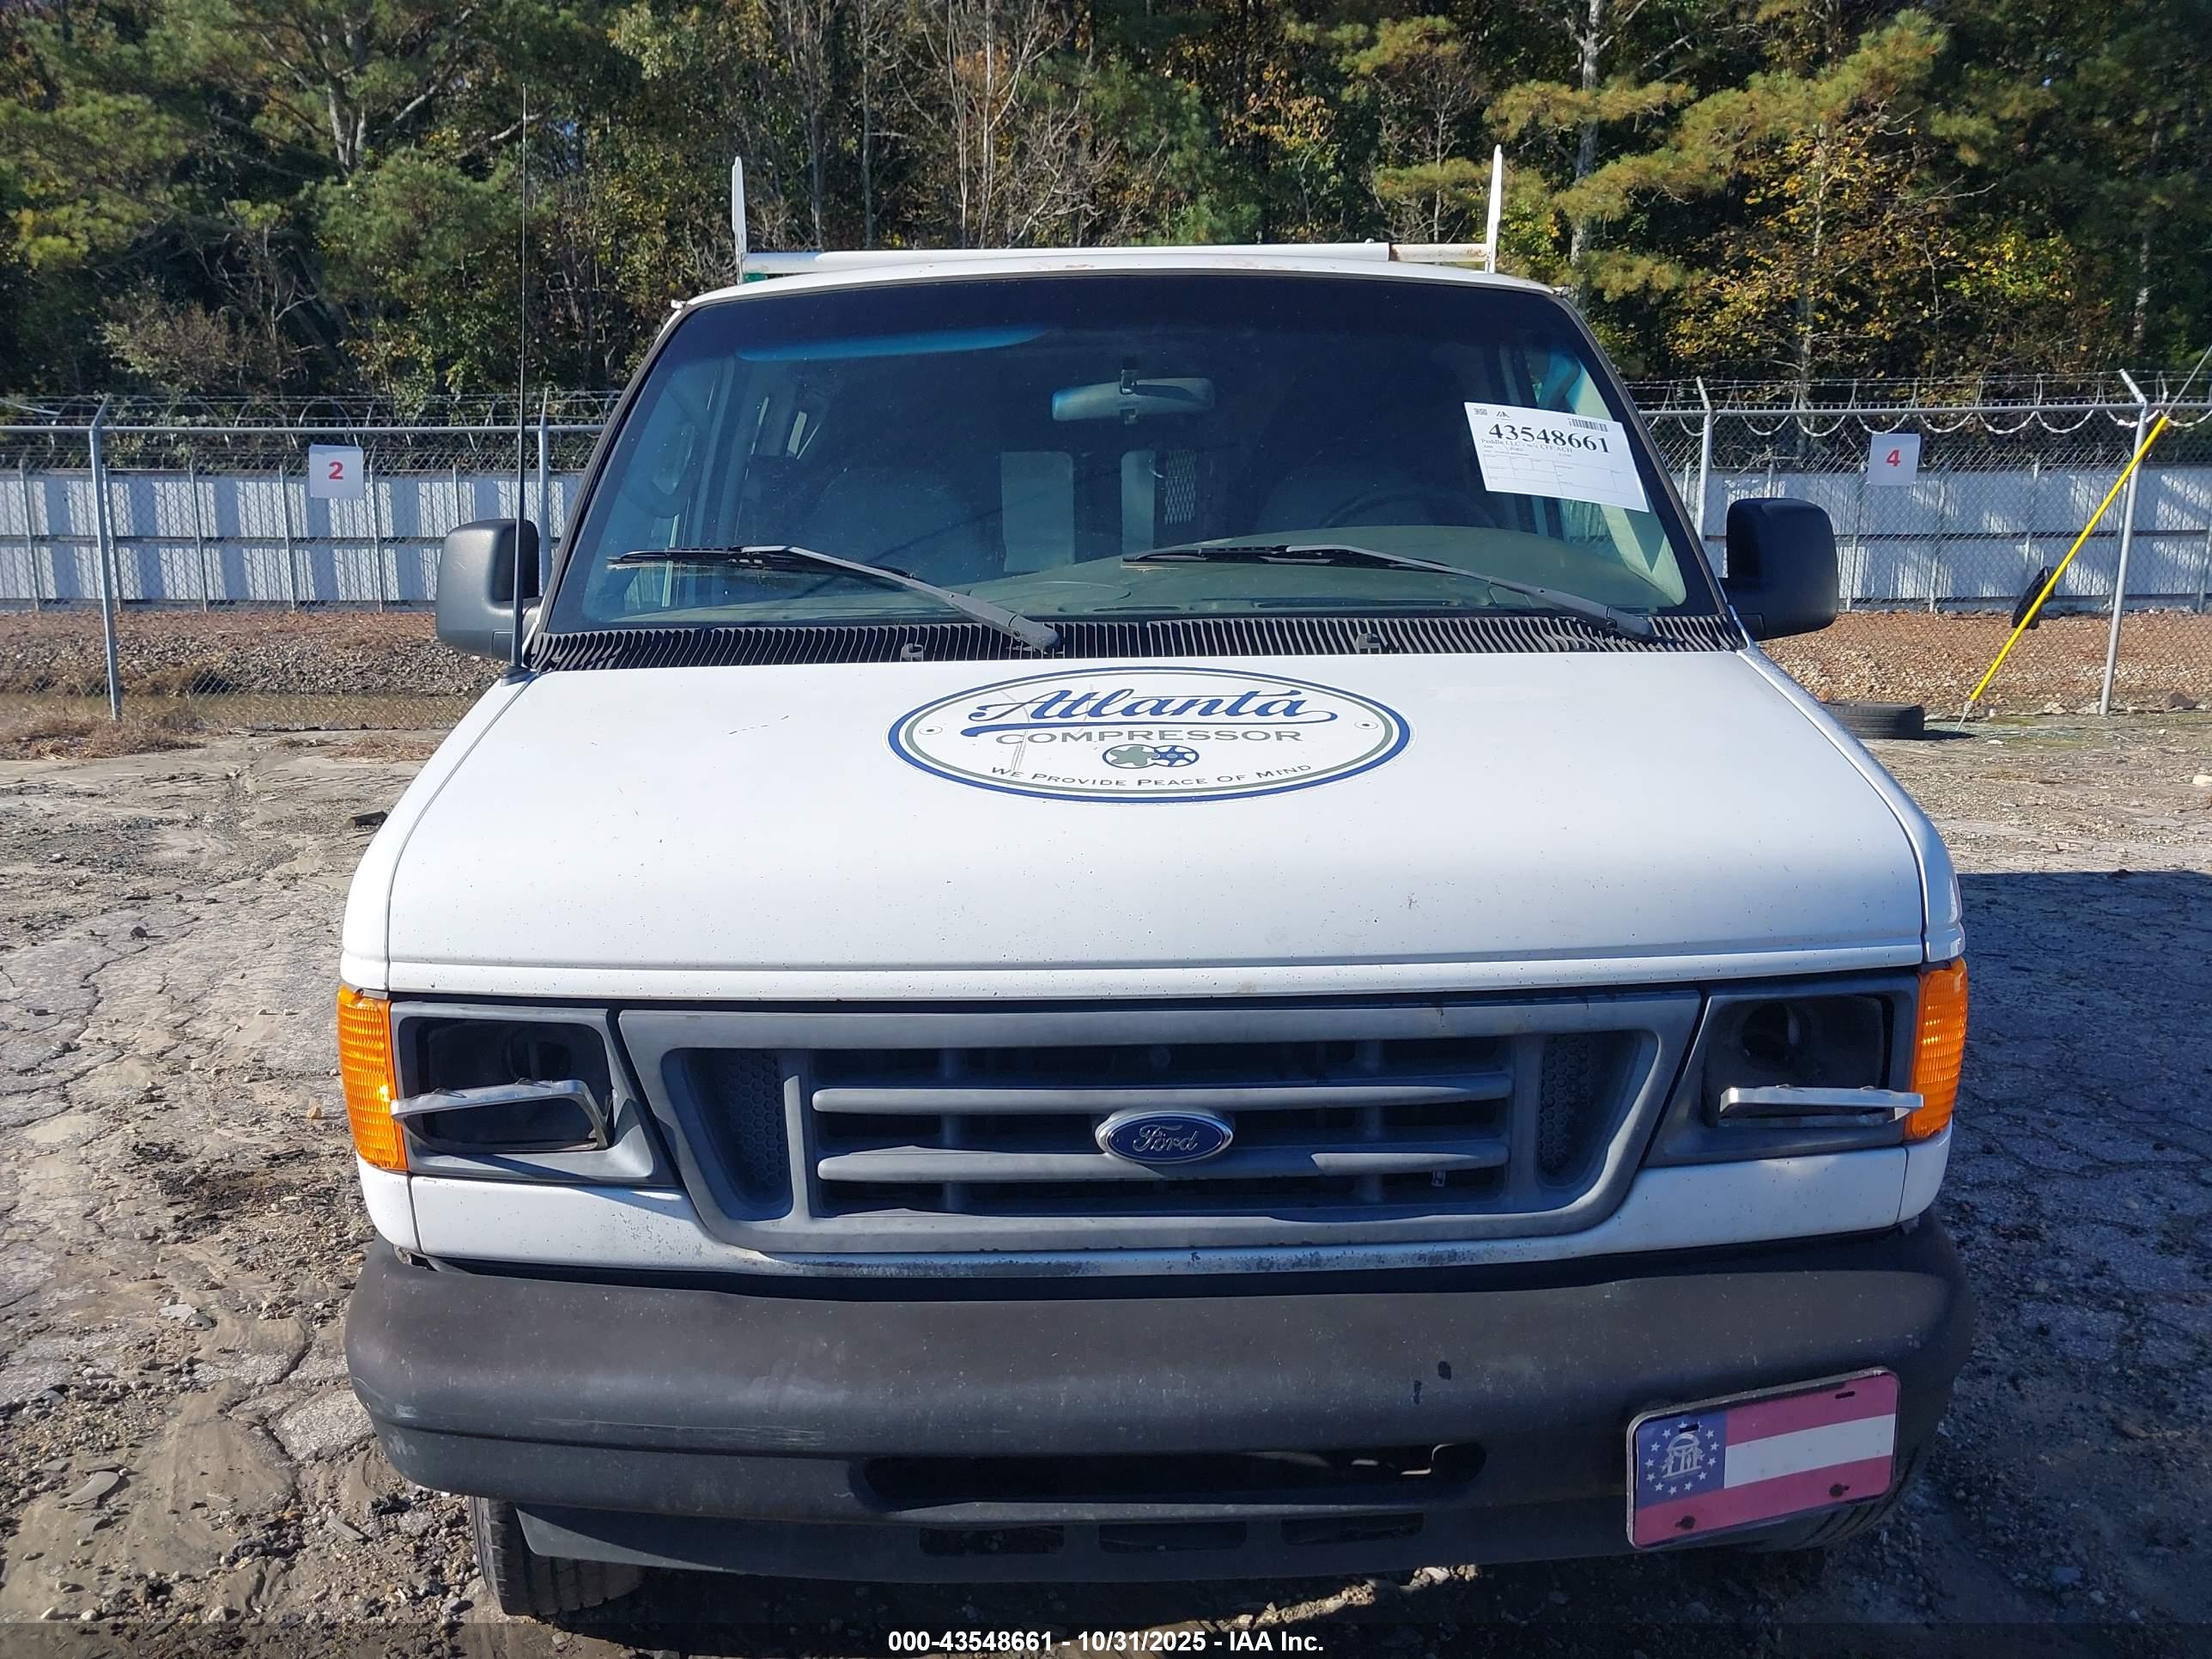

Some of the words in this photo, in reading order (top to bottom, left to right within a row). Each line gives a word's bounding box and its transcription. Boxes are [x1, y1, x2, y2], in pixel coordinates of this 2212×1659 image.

[1489, 422, 1611, 454] 43548661
[1886, 449, 1901, 467] 4
[328, 461, 344, 480] 2
[968, 689, 1338, 723] Atlanta
[995, 729, 1304, 744] COMPRESSOR
[991, 767, 1024, 778] WE
[1031, 773, 1127, 787] PROVIDE
[1137, 778, 1208, 787] PEACE
[1216, 774, 1246, 783] OF
[1255, 764, 1312, 779] MIND
[1132, 1124, 1200, 1152] Ford
